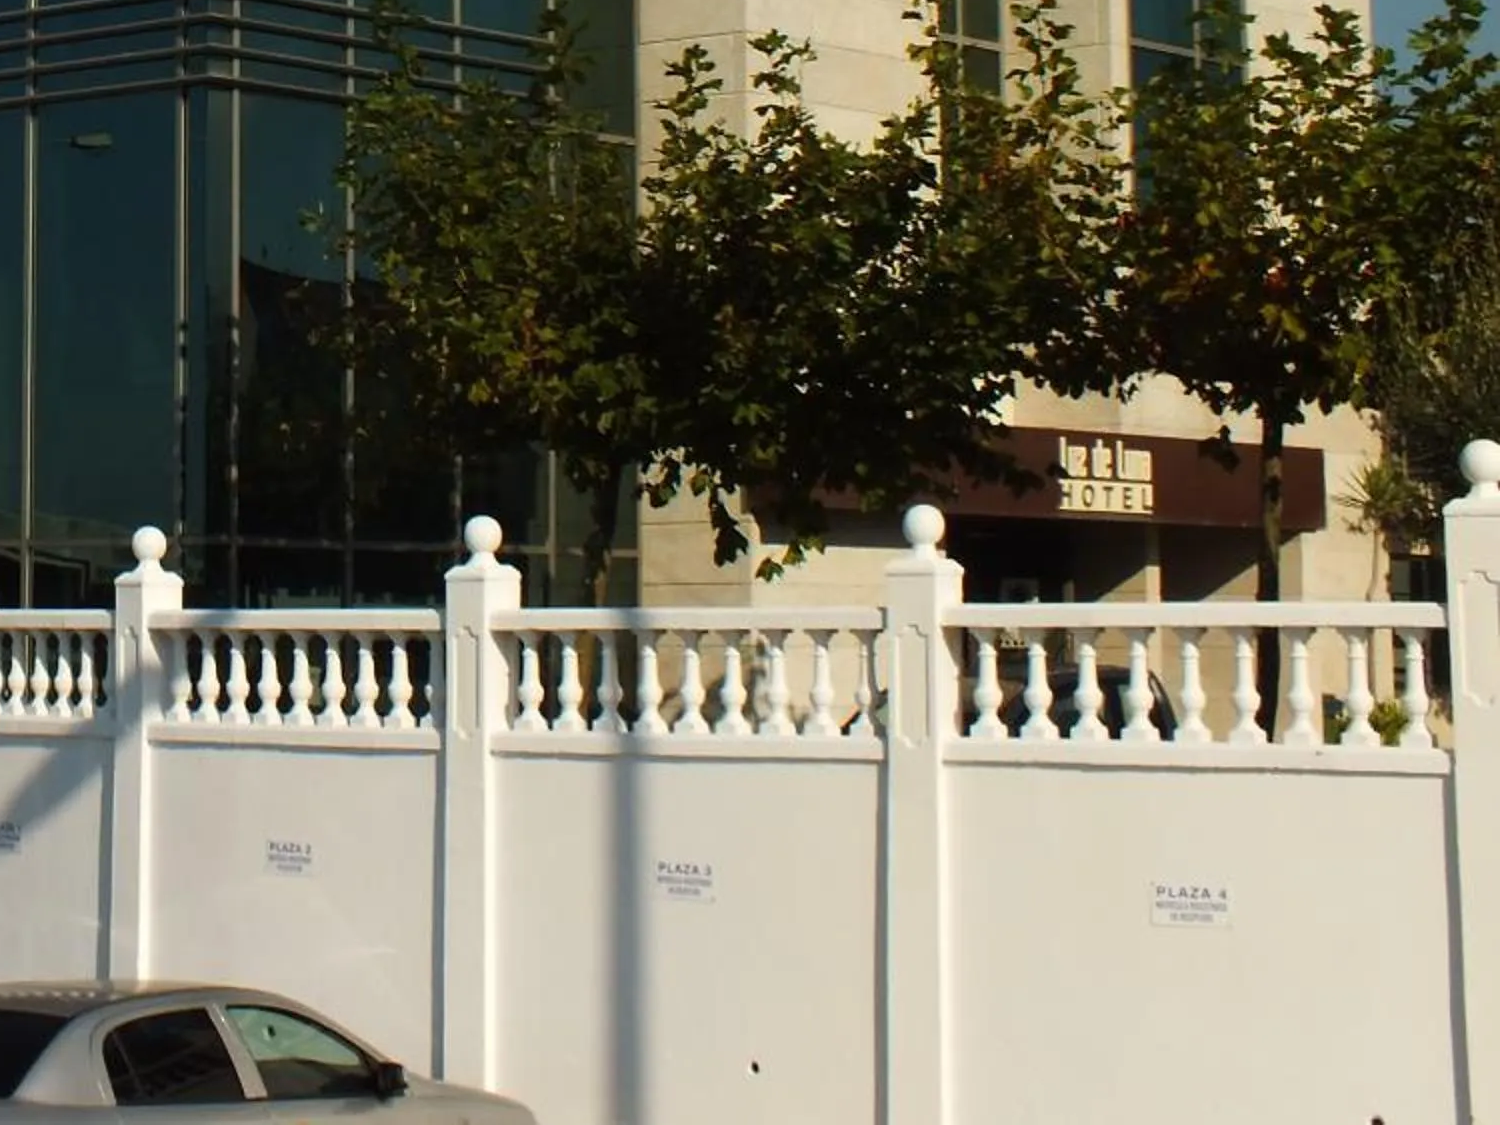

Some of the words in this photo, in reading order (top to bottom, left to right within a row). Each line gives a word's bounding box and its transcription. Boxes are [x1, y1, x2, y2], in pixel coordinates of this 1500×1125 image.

[1059, 482, 1153, 511] HOTEL
[658, 861, 700, 875] PLAZA
[1156, 886, 1211, 899] PLAZA
